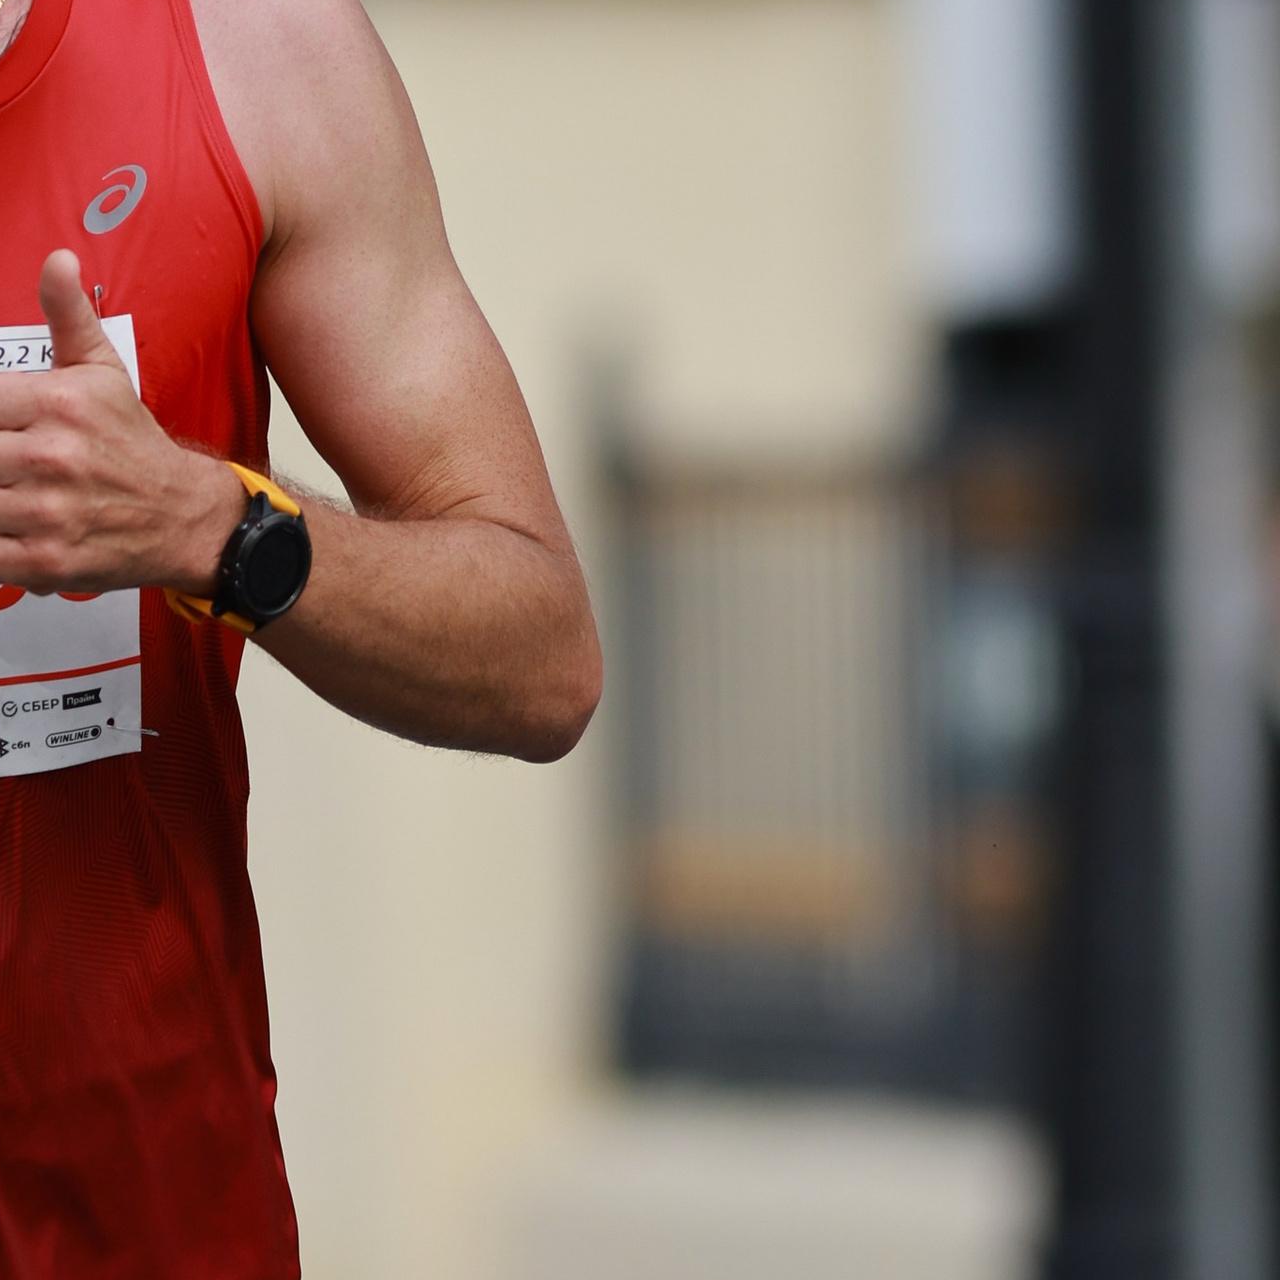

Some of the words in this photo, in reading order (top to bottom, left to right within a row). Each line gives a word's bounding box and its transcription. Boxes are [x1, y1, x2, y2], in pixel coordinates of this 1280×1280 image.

[21, 698, 60, 713] СБЕР
[66, 693, 96, 708] Прайм
[49, 729, 90, 745] WINLINE
[11, 740, 31, 751] сбп
